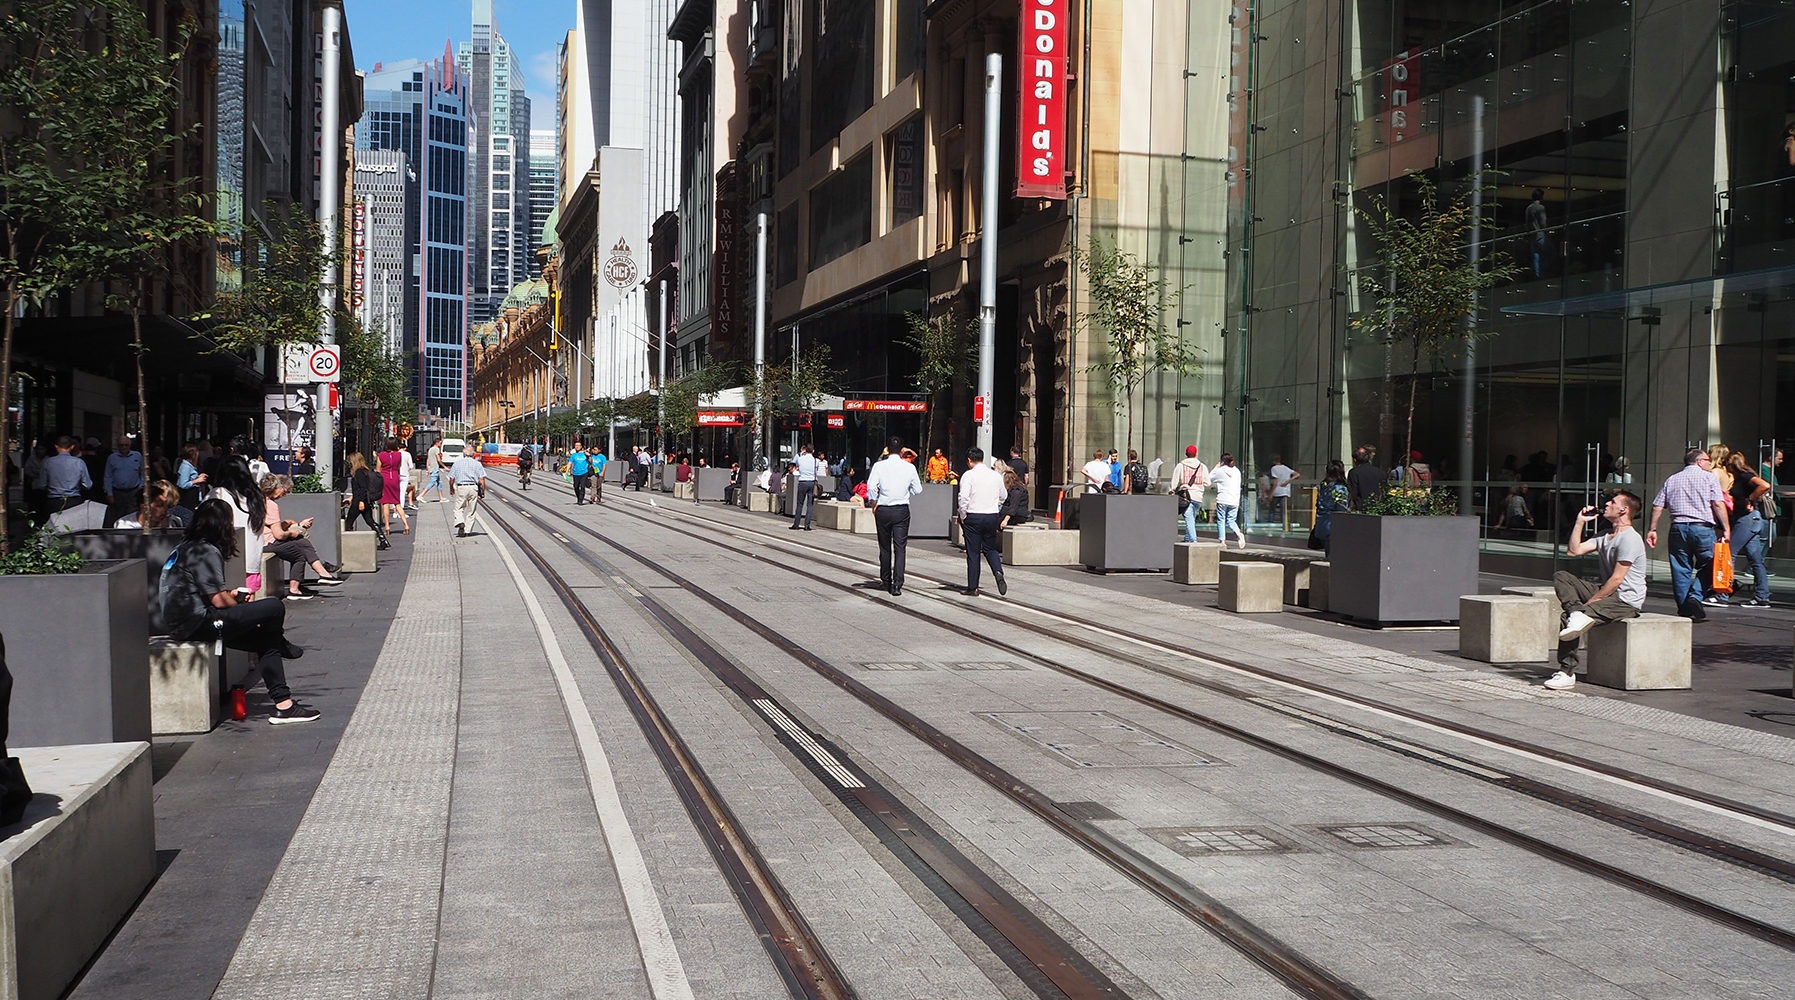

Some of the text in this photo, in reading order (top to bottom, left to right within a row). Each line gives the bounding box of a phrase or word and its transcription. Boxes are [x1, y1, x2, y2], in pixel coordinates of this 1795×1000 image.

[356, 161, 397, 175] Ausgrid
[610, 257, 631, 266] HEALTH
[612, 265, 629, 278] HCF
[316, 357, 333, 369] 20
[866, 402, 905, 410] McDonald's
